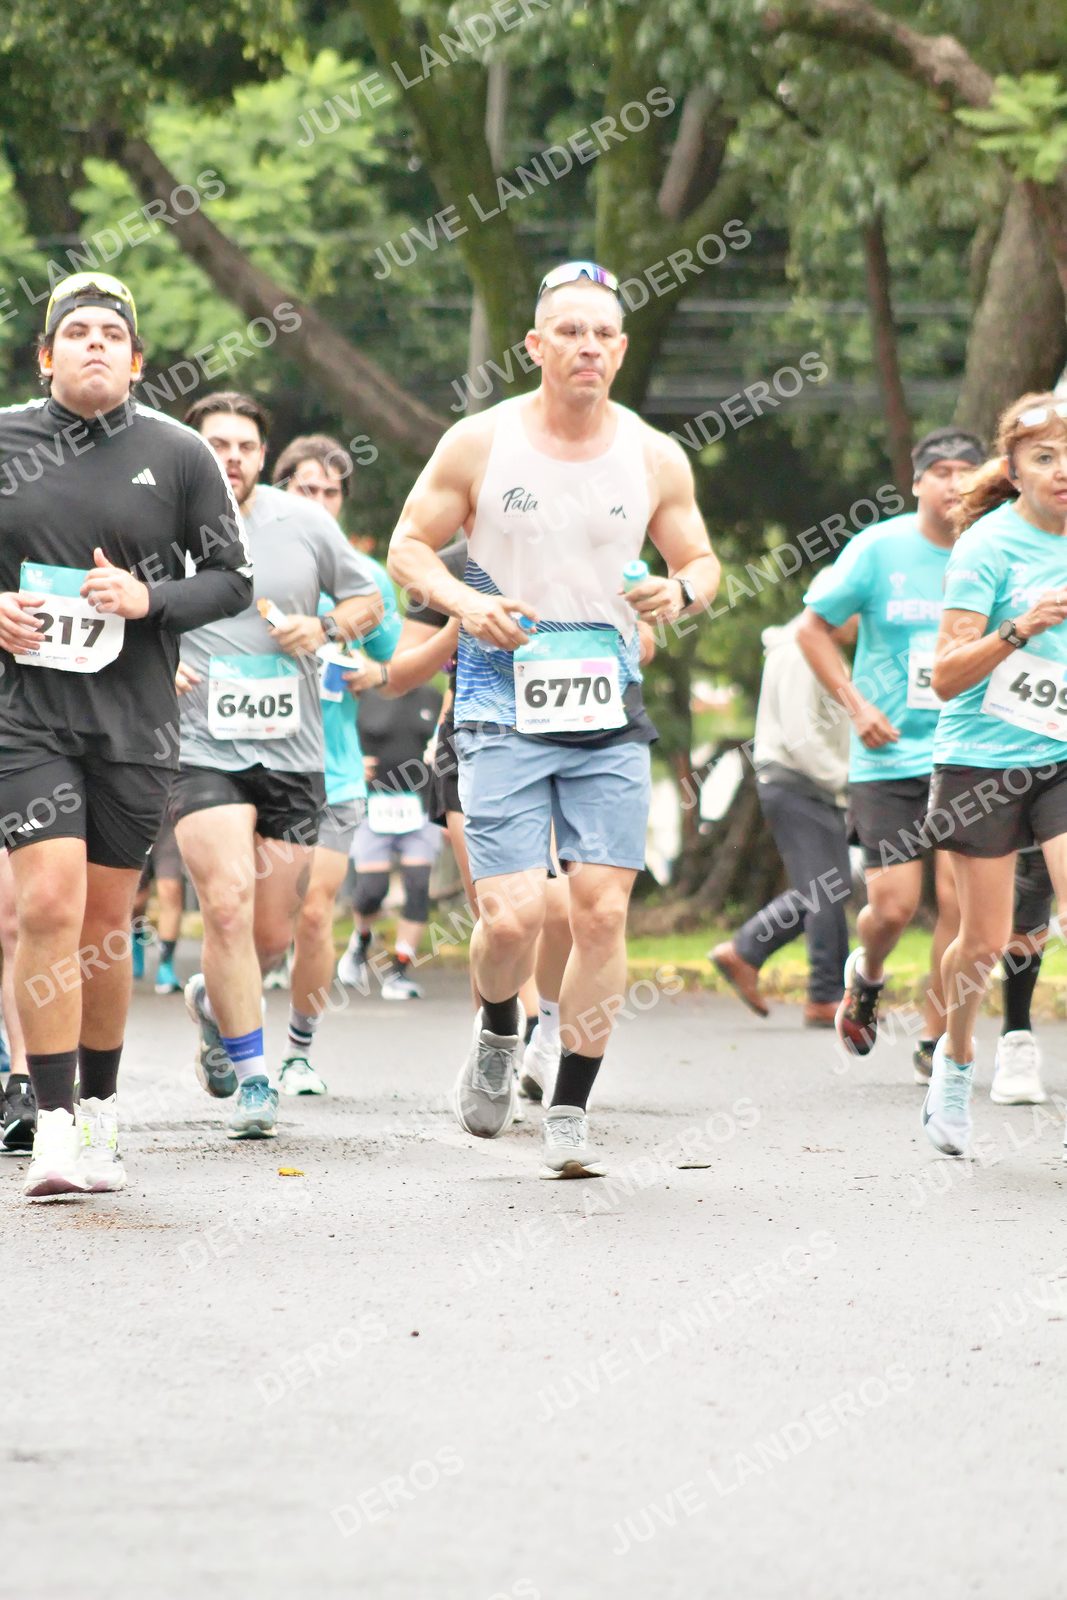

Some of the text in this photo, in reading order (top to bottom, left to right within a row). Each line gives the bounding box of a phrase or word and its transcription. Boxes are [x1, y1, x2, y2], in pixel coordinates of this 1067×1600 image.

[502, 487, 538, 512] Pata
[524, 676, 612, 709] 6770
[217, 693, 293, 719] 6405
